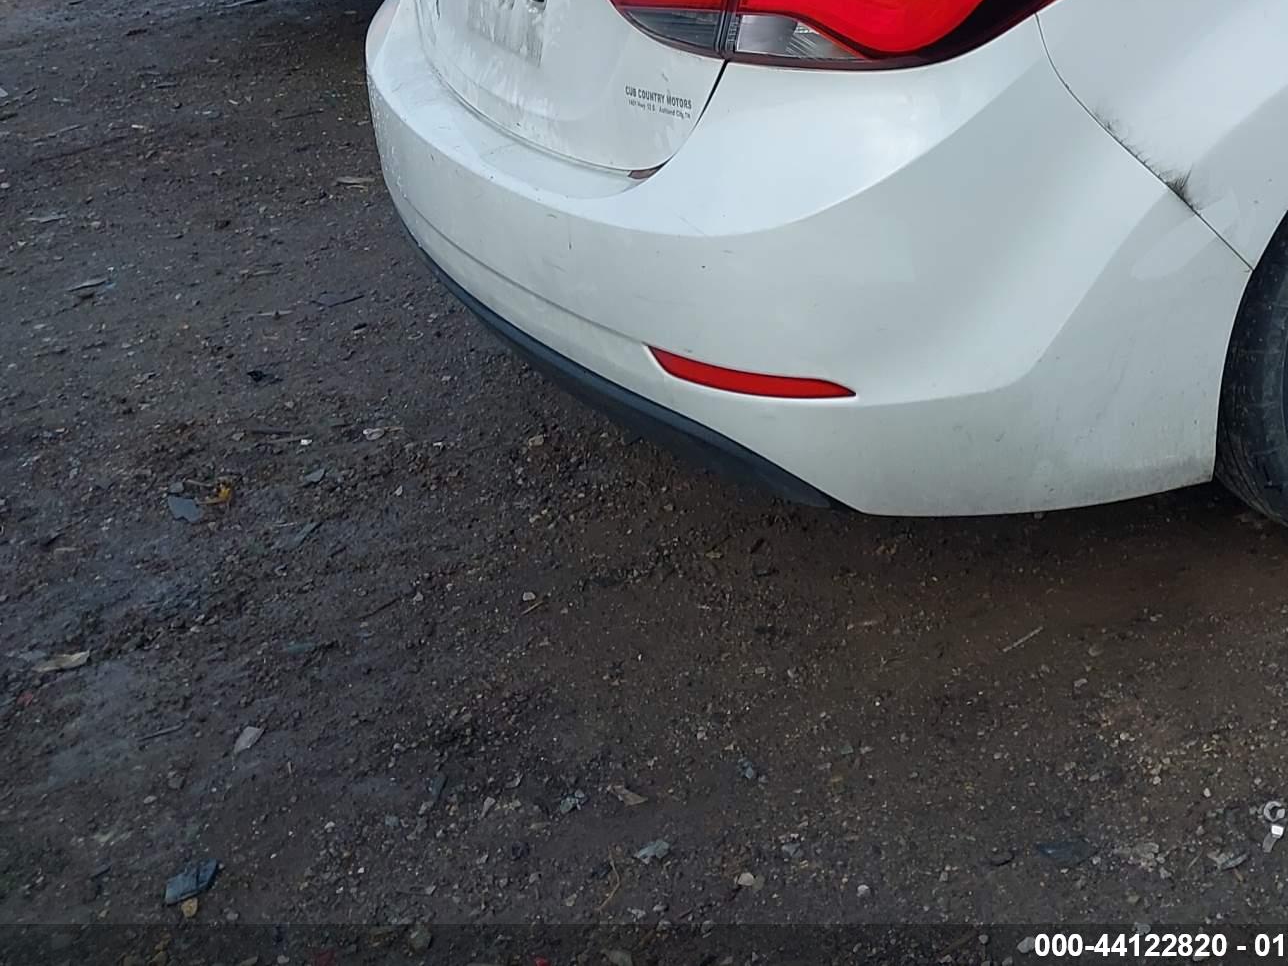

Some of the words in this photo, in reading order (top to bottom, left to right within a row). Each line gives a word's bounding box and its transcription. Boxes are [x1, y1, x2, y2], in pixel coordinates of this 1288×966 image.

[625, 85, 637, 98] CUB
[637, 88, 665, 104] COUNTRY
[666, 94, 692, 110] MOTORS
